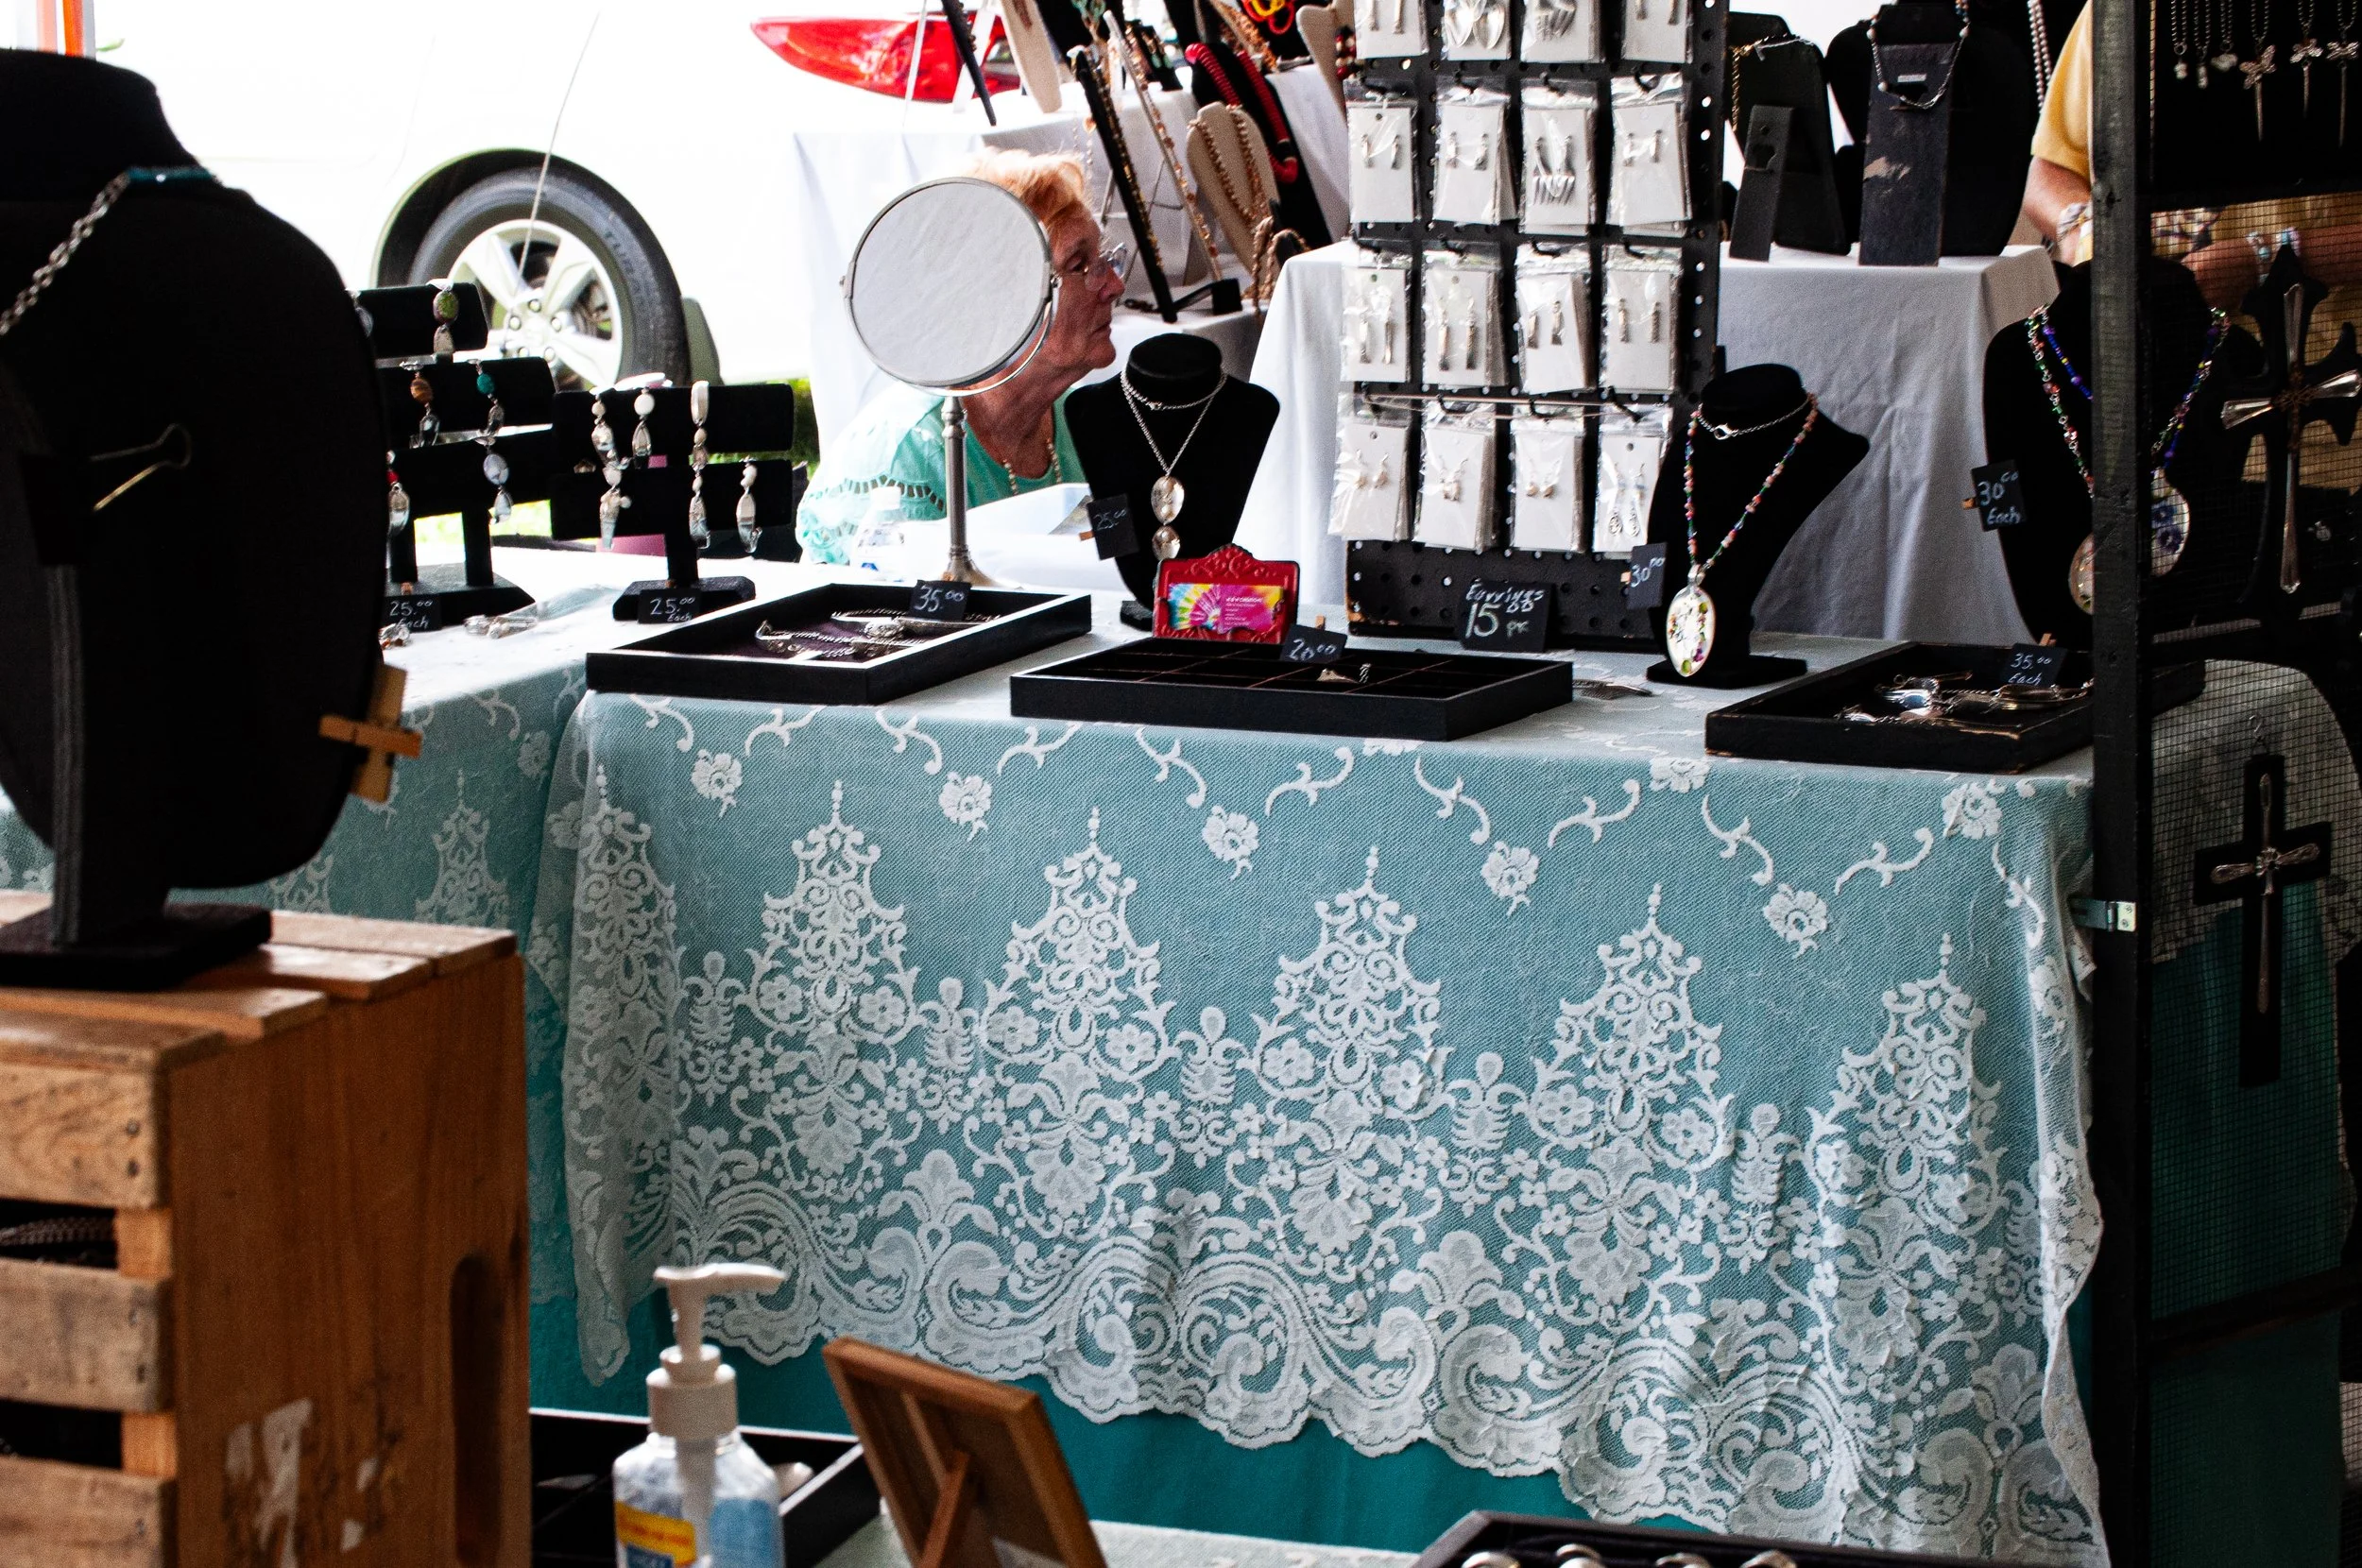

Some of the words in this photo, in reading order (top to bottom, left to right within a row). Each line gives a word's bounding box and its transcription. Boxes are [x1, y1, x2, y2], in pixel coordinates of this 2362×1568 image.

[1987, 506, 2021, 525] Each
[667, 613, 693, 622] Each
[2008, 673, 2042, 686] Each
